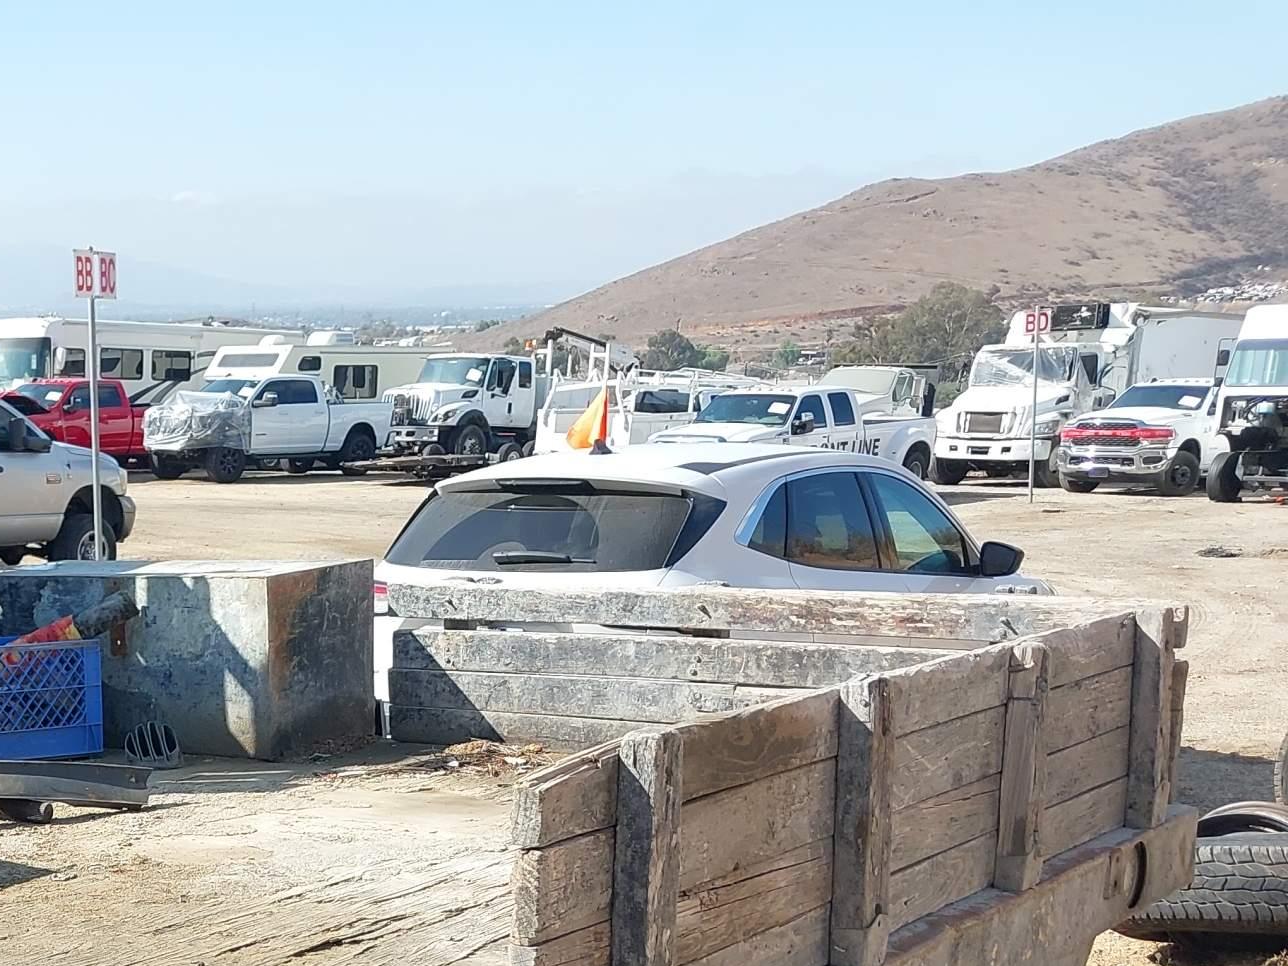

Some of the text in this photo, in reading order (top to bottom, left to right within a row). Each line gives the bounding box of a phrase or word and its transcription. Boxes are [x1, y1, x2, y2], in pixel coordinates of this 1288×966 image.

[76, 255, 93, 292] BB
[100, 257, 116, 294] BC
[1025, 311, 1049, 333] BD
